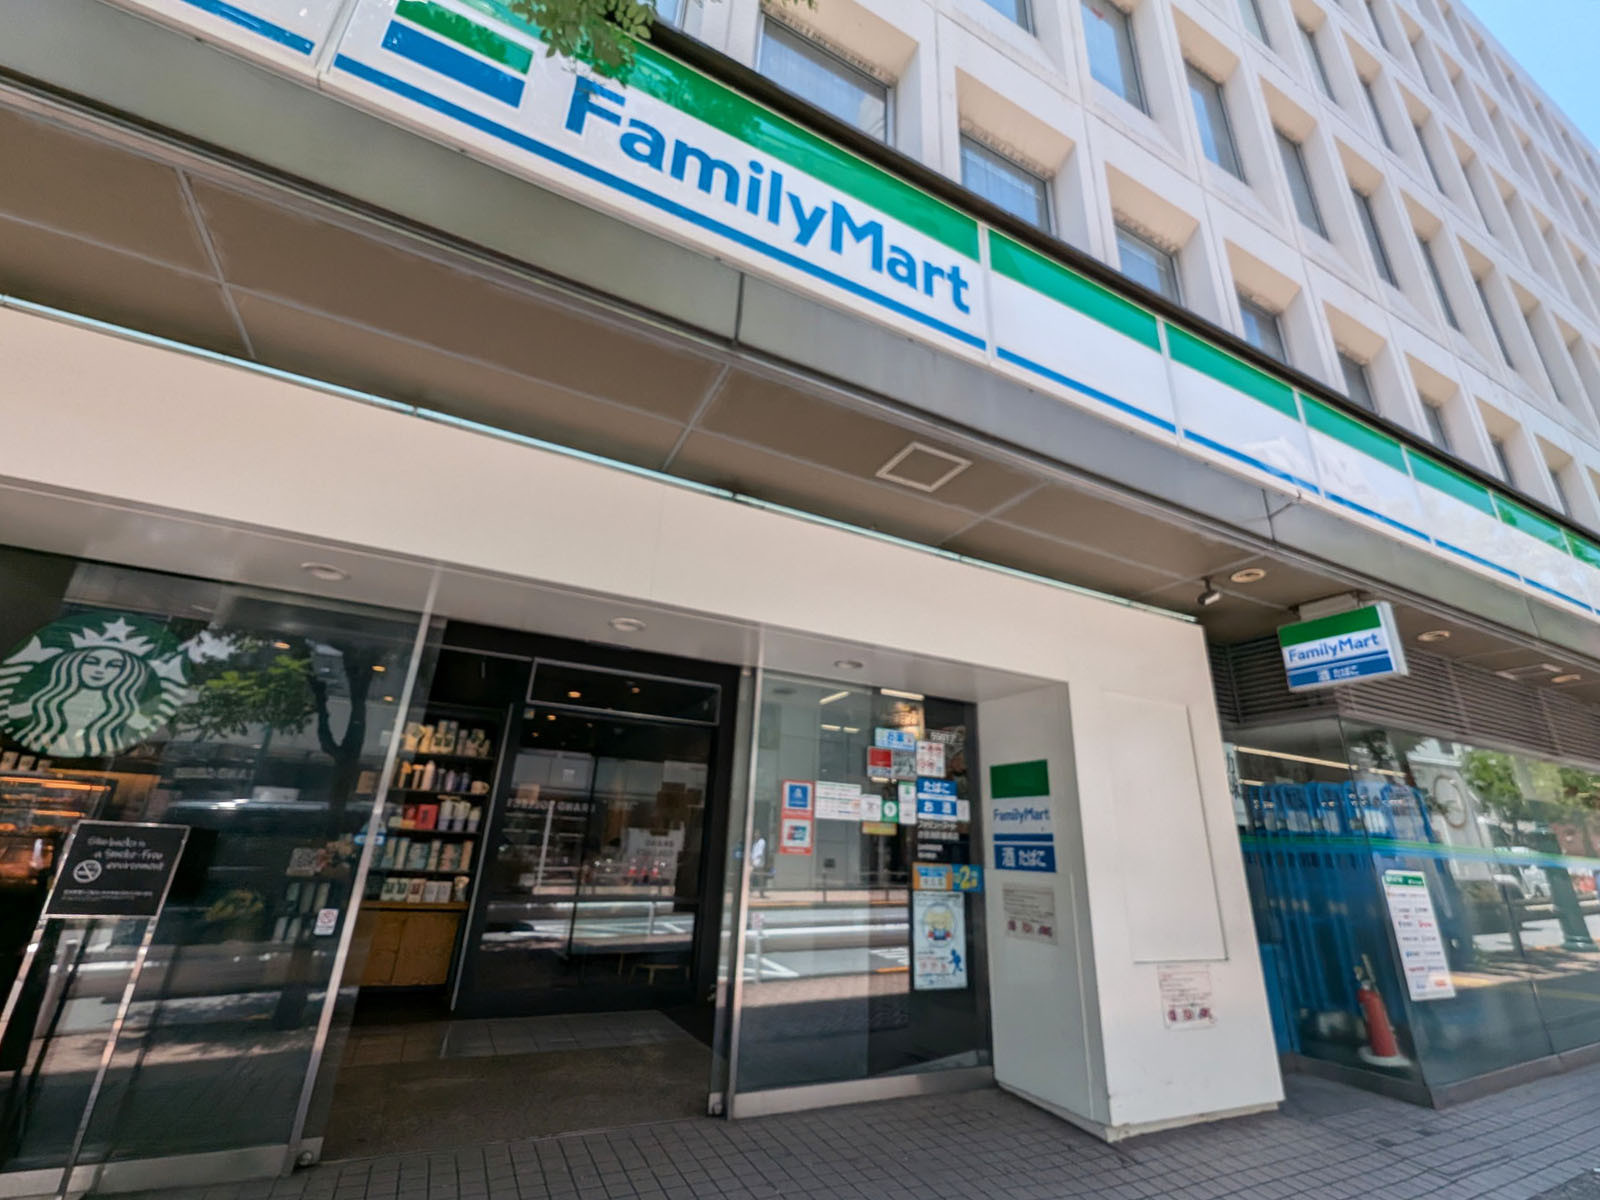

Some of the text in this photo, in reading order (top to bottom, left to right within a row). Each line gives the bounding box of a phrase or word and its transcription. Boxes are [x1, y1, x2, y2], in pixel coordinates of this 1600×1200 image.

[564, 74, 970, 314] FamilyMart
[1288, 633, 1379, 662] FamilyMart
[923, 781, 951, 794] たばこ
[993, 808, 1050, 824] FamilyMart
[1002, 847, 1047, 868] 酒 たばこ
